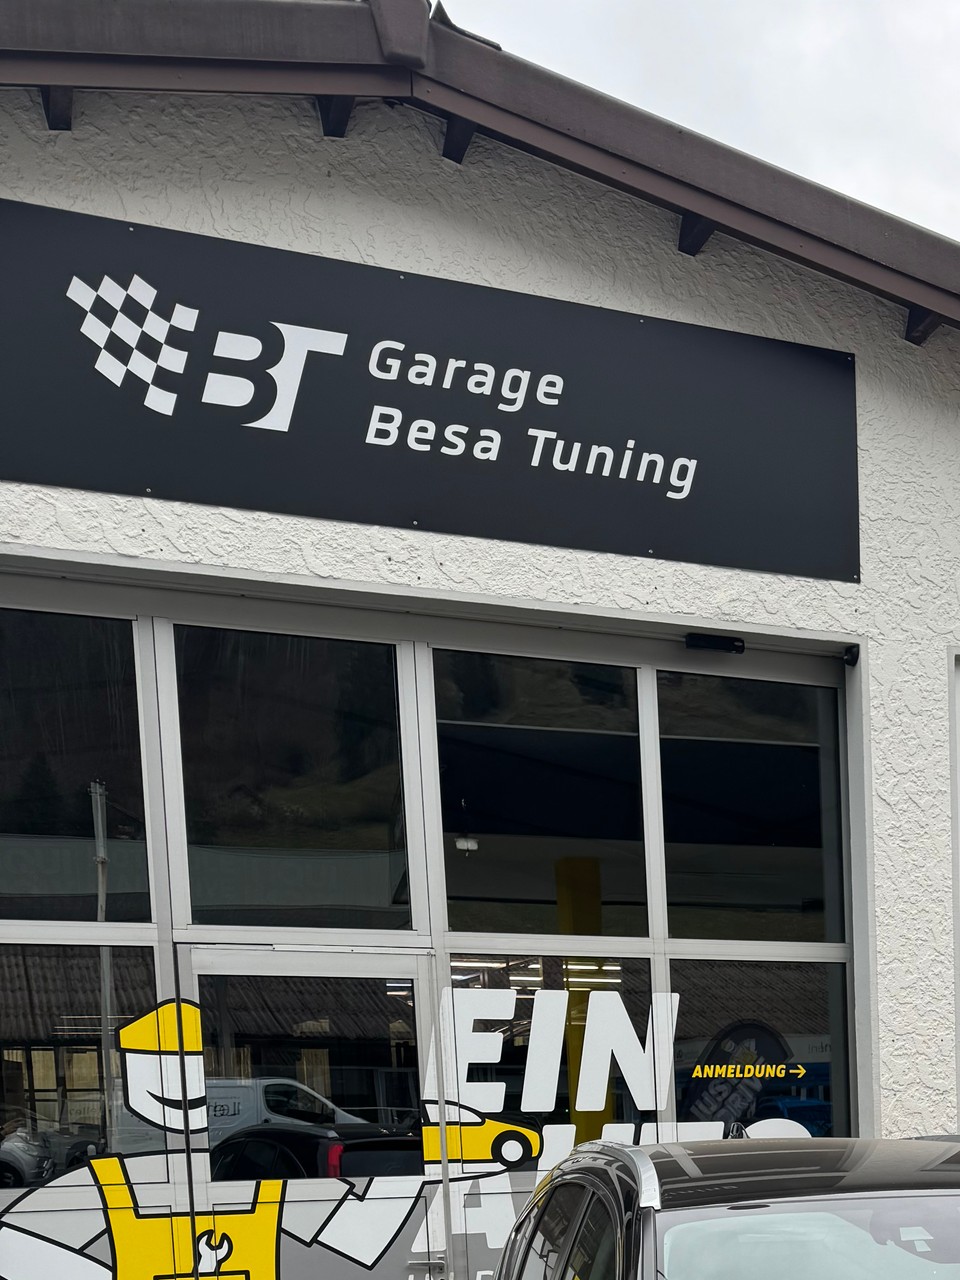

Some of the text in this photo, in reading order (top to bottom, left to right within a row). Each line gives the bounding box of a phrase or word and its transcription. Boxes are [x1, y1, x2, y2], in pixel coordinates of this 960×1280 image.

[368, 340, 566, 412] Garage
[365, 405, 699, 500] Besa Tuning
[424, 986, 680, 1113] EIN
[691, 1064, 787, 1078] ANMELDUNG
